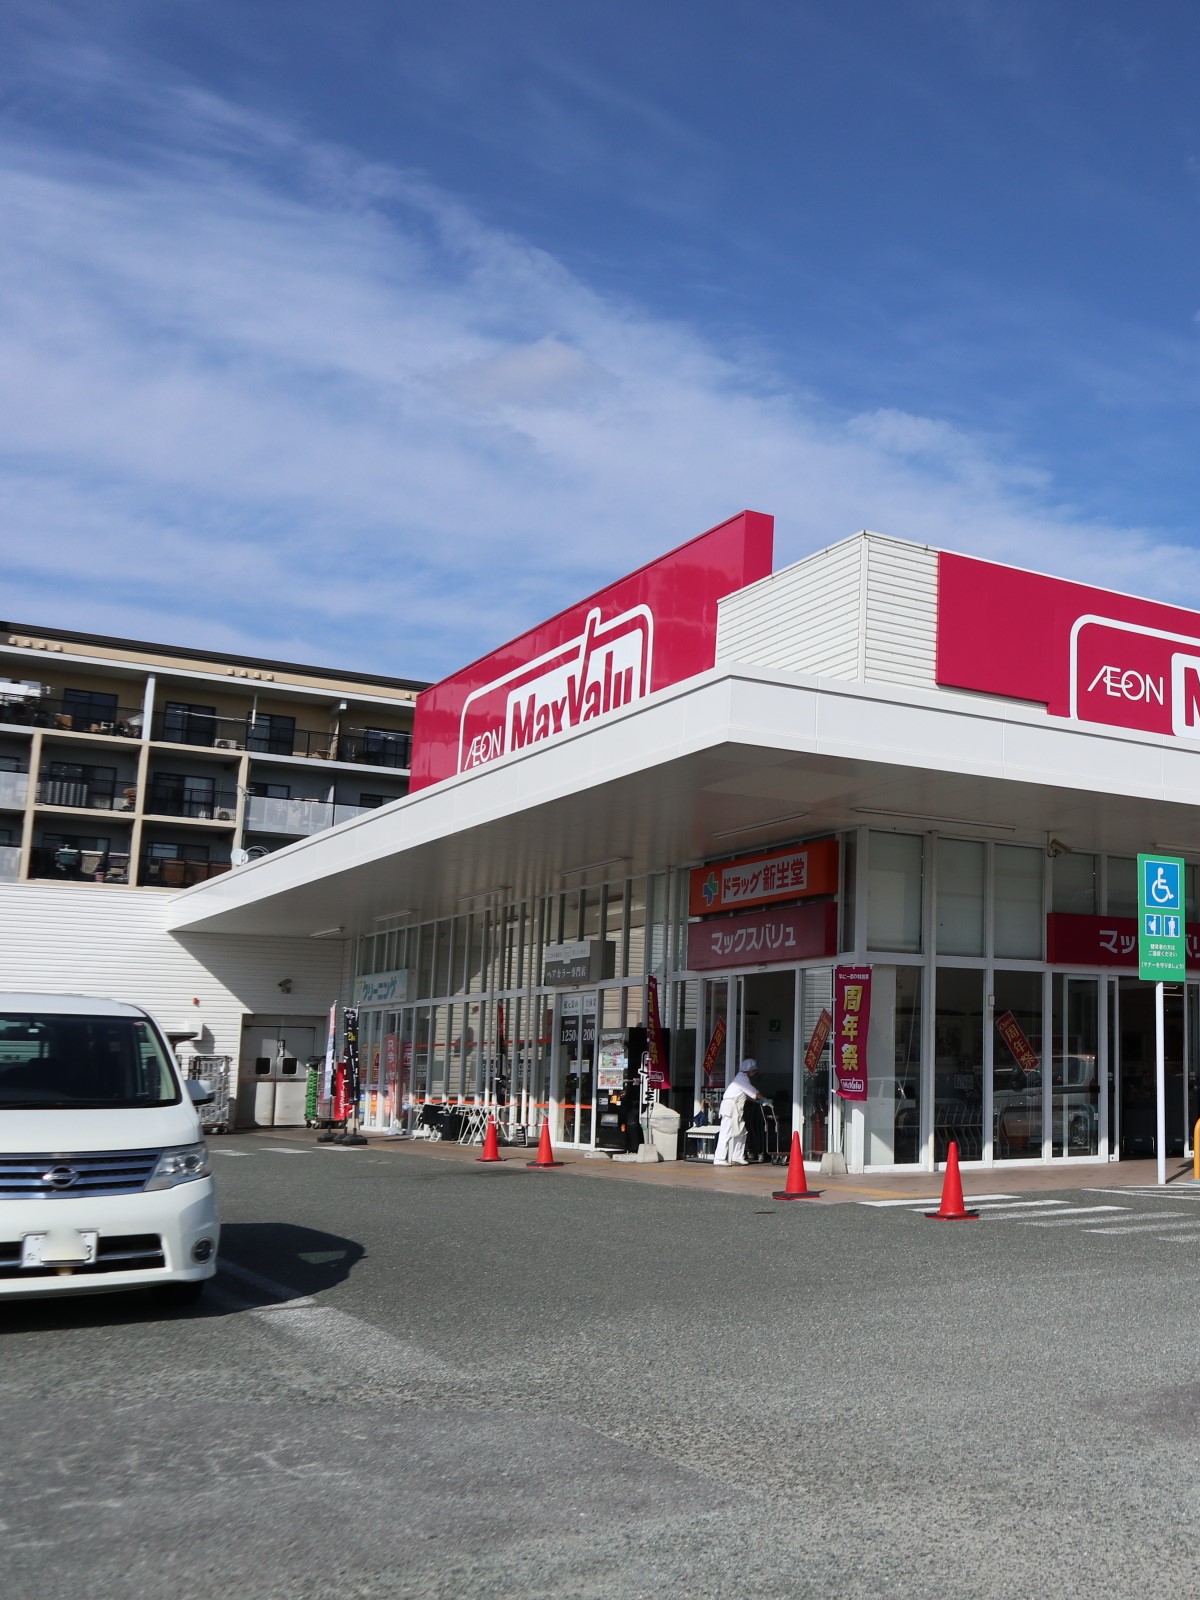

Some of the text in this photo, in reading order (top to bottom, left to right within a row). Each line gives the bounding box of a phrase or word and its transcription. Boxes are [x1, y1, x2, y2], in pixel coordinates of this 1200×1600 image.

[511, 617, 633, 752] MaxValu
[723, 858, 804, 898] ドラッグ新生堂
[711, 923, 796, 955] マックスバリュ
[363, 976, 397, 1001] クリーニング
[842, 985, 863, 1072] 周年祭
[1005, 1024, 1034, 1069] 周年祭
